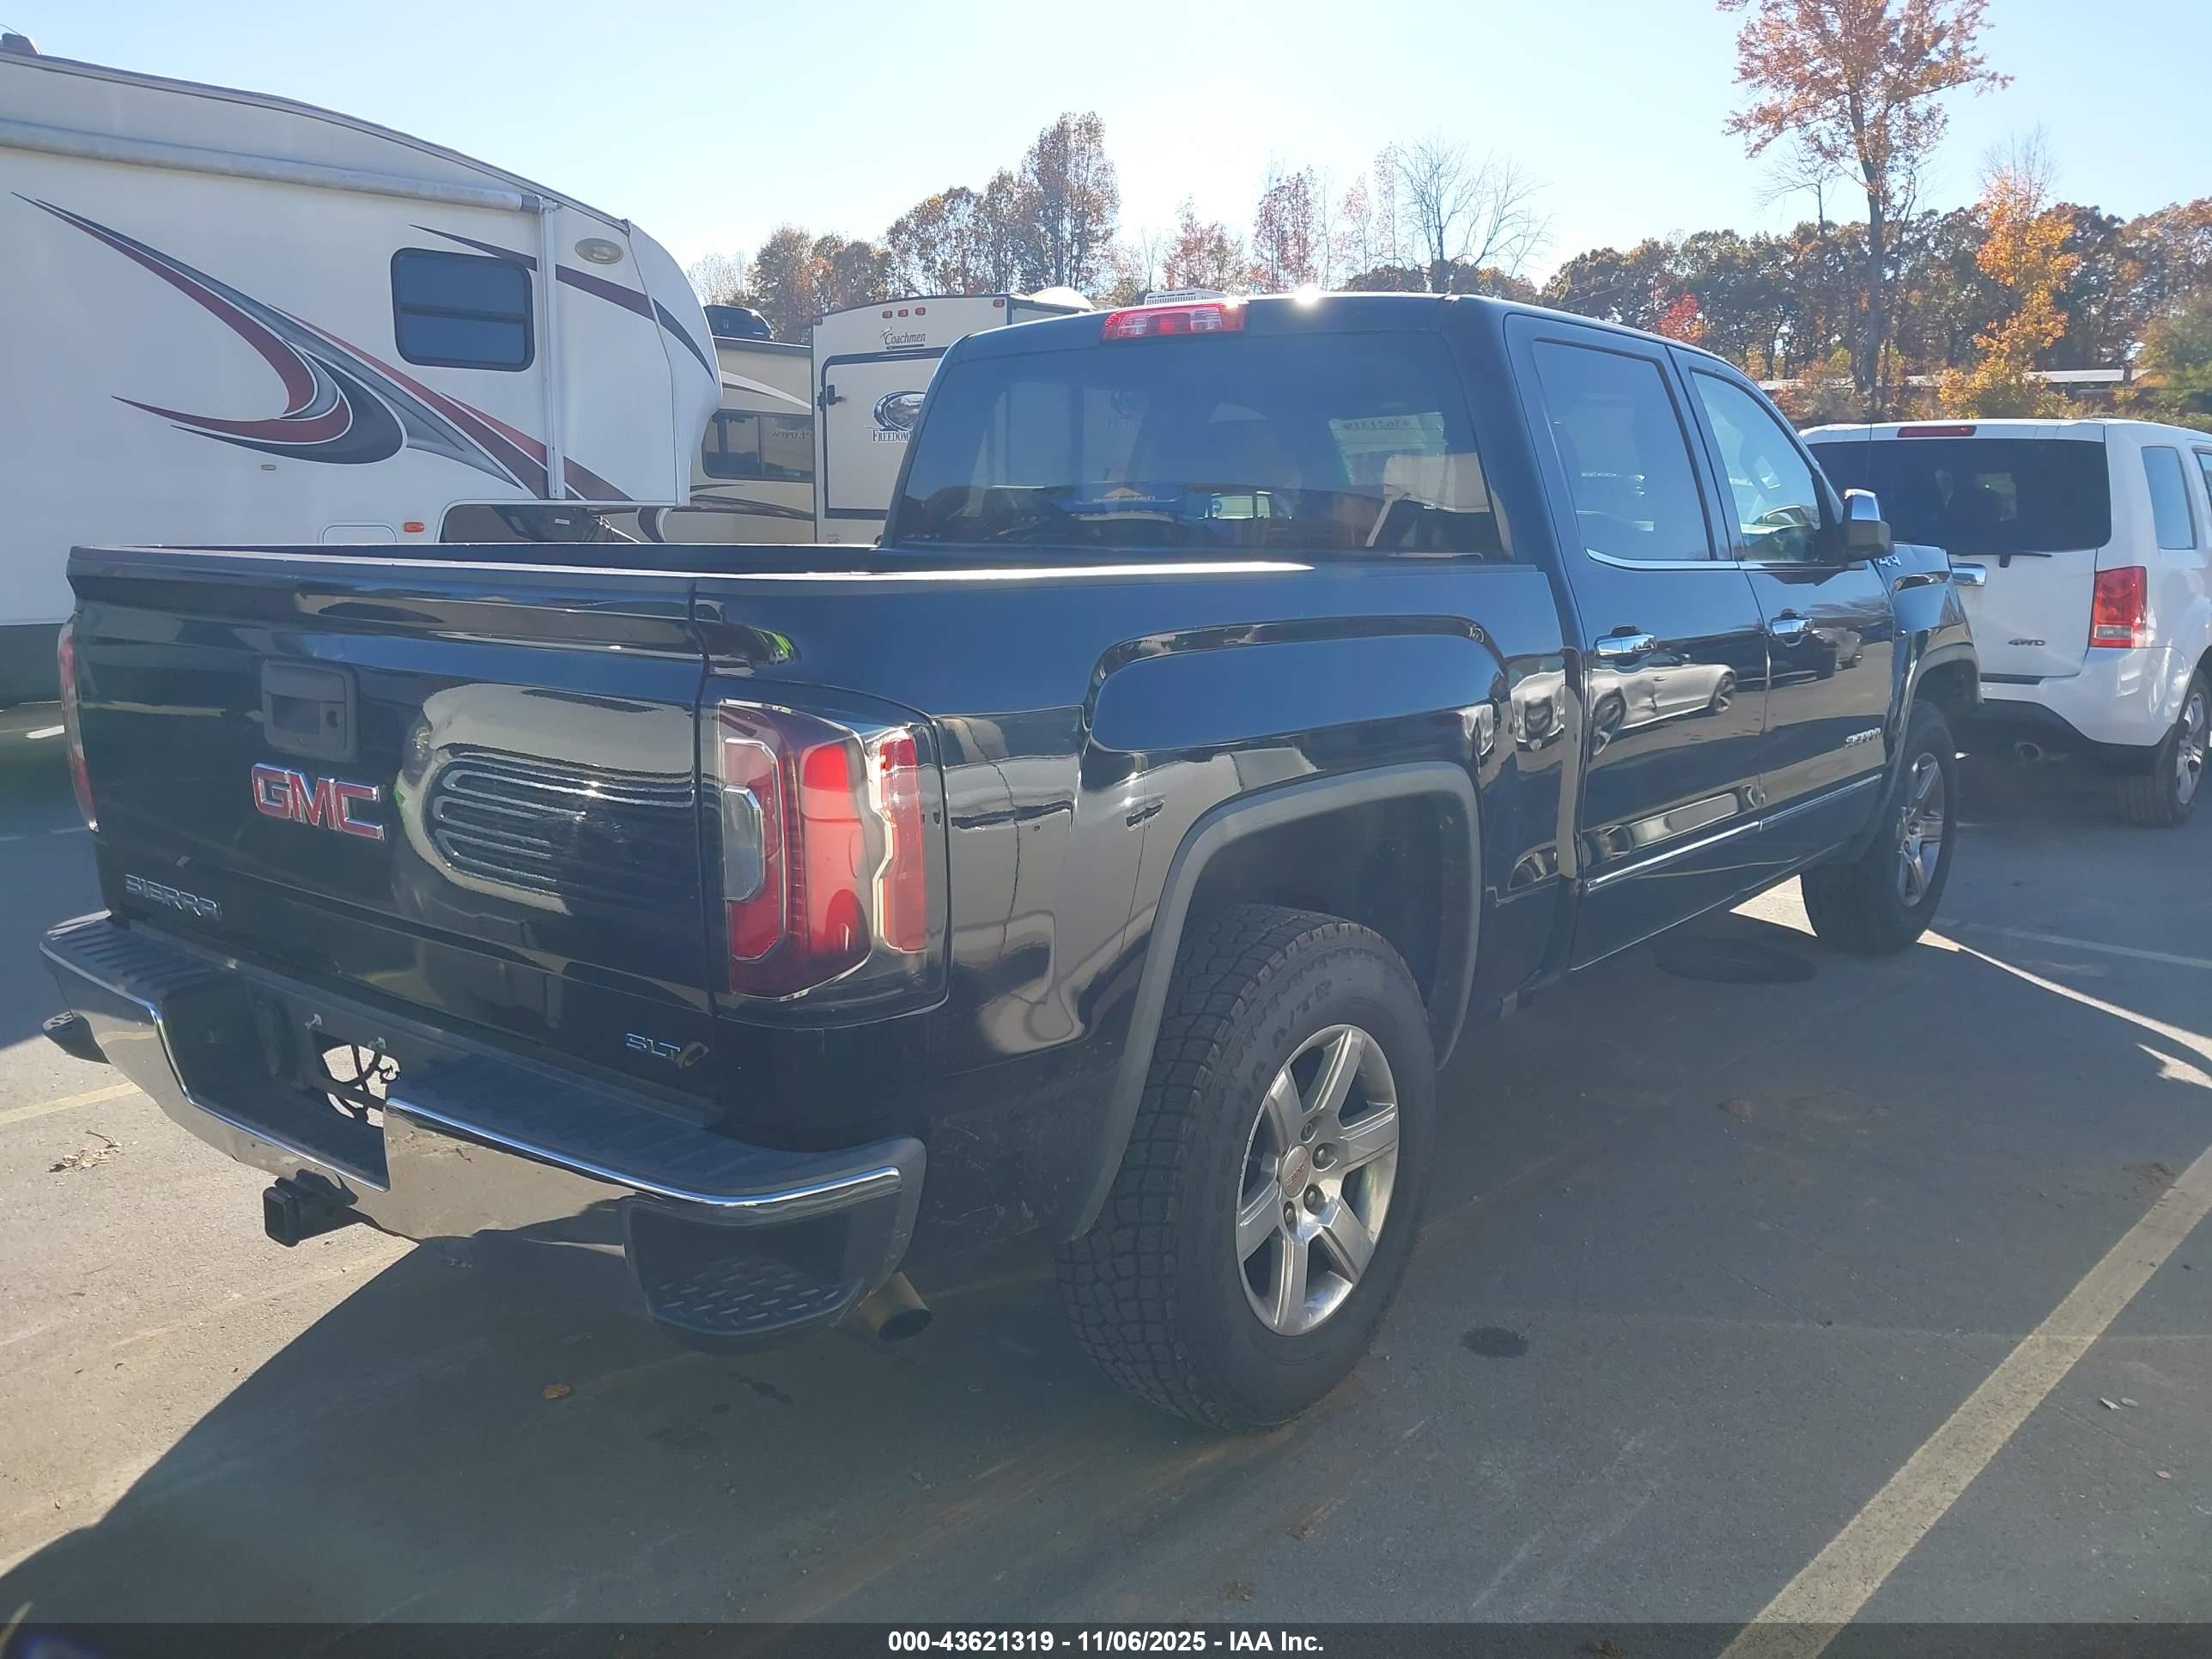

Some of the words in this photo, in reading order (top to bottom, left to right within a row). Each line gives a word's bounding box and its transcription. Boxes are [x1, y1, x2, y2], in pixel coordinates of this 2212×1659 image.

[884, 331, 927, 345] Coachmen
[872, 429, 909, 442] FREEDOM
[2008, 638, 2046, 647] 4WD
[252, 763, 386, 842] GMC
[125, 873, 222, 921] SIERRA
[625, 1033, 681, 1061] SLT
